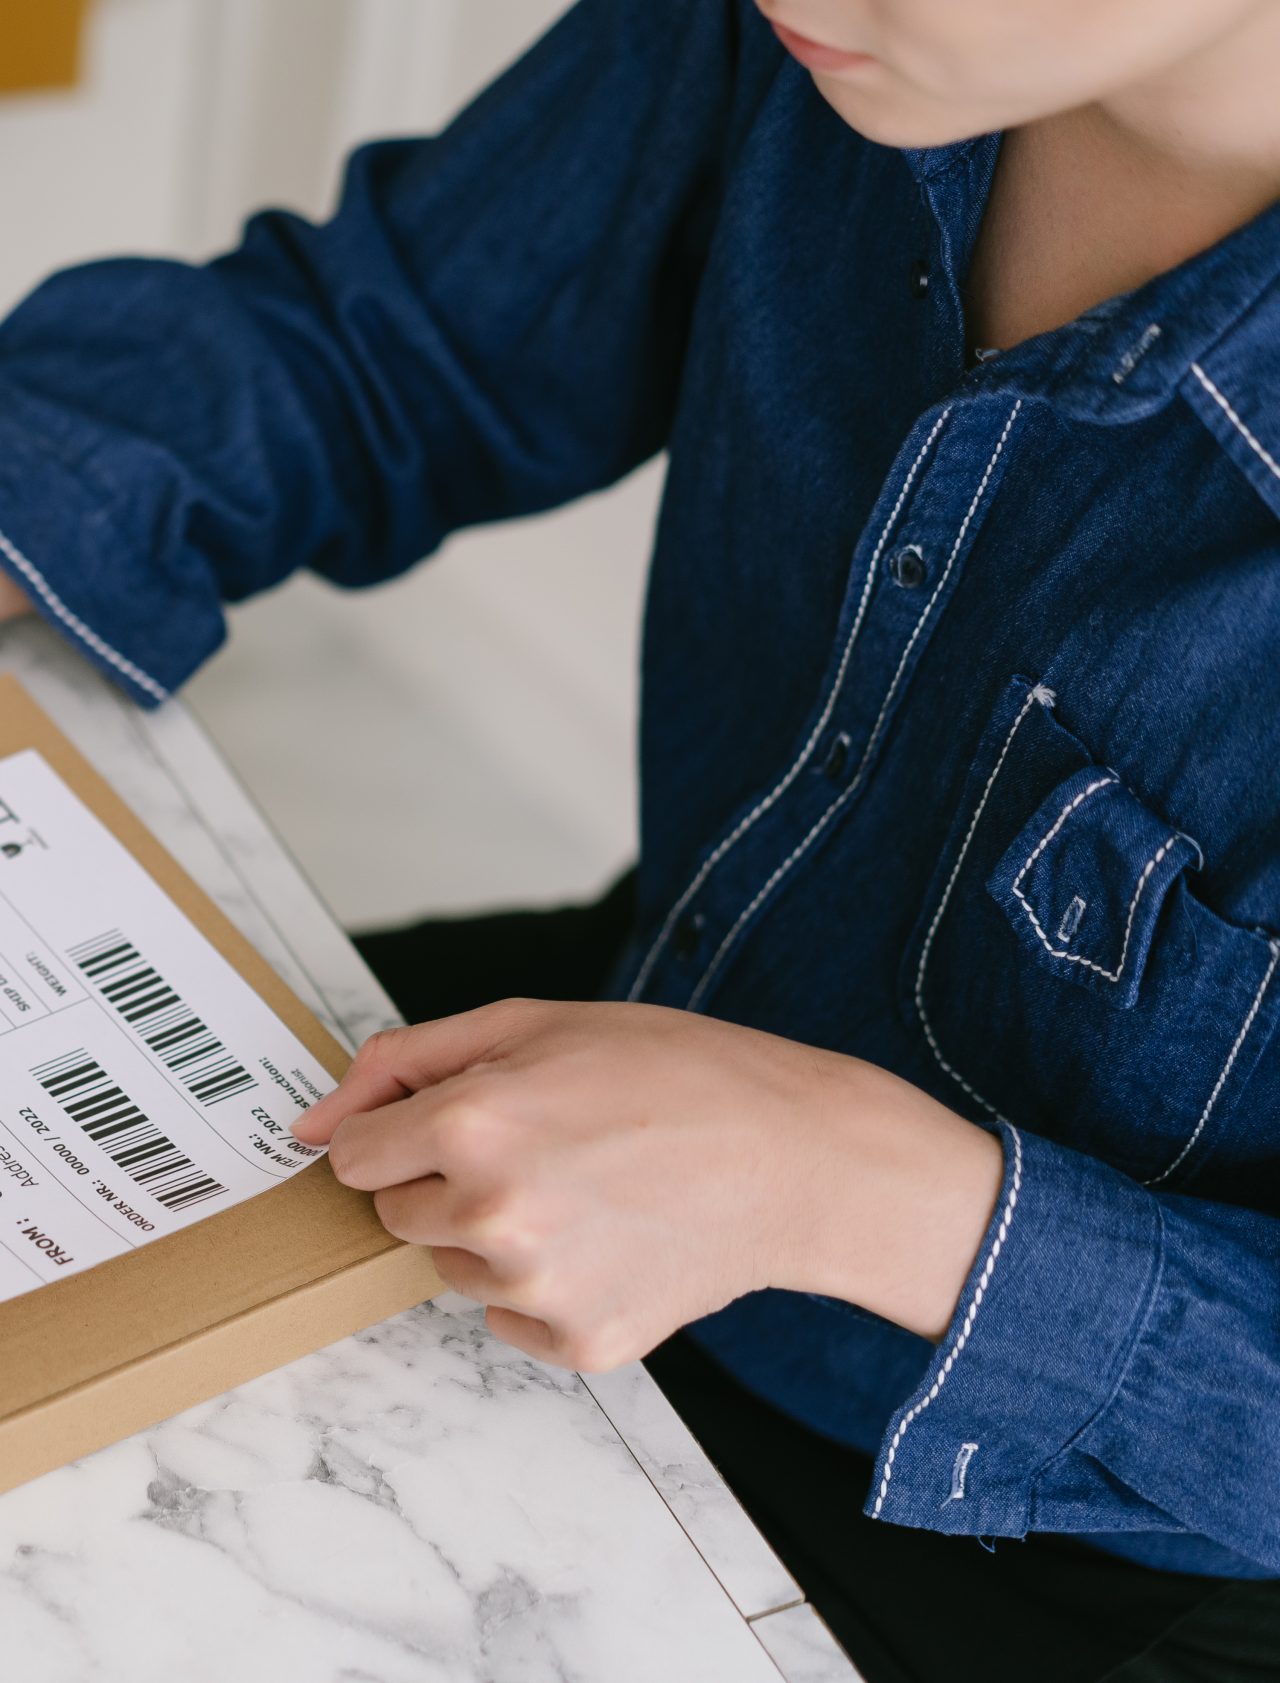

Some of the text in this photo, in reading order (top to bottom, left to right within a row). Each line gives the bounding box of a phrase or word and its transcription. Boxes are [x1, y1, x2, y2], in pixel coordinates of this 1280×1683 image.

[26, 951, 67, 996] WEIGHT:
[3, 988, 31, 1012] SHIP
[259, 1057, 310, 1108] struction:
[19, 1107, 50, 1134] 2022
[251, 1107, 283, 1134] 2022
[53, 1144, 90, 1175] 00000
[249, 1134, 303, 1168] ITEM NR.:
[92, 1180, 118, 1202] NR.:
[113, 1201, 155, 1231] ORDER
[22, 1226, 74, 1265] FROM
